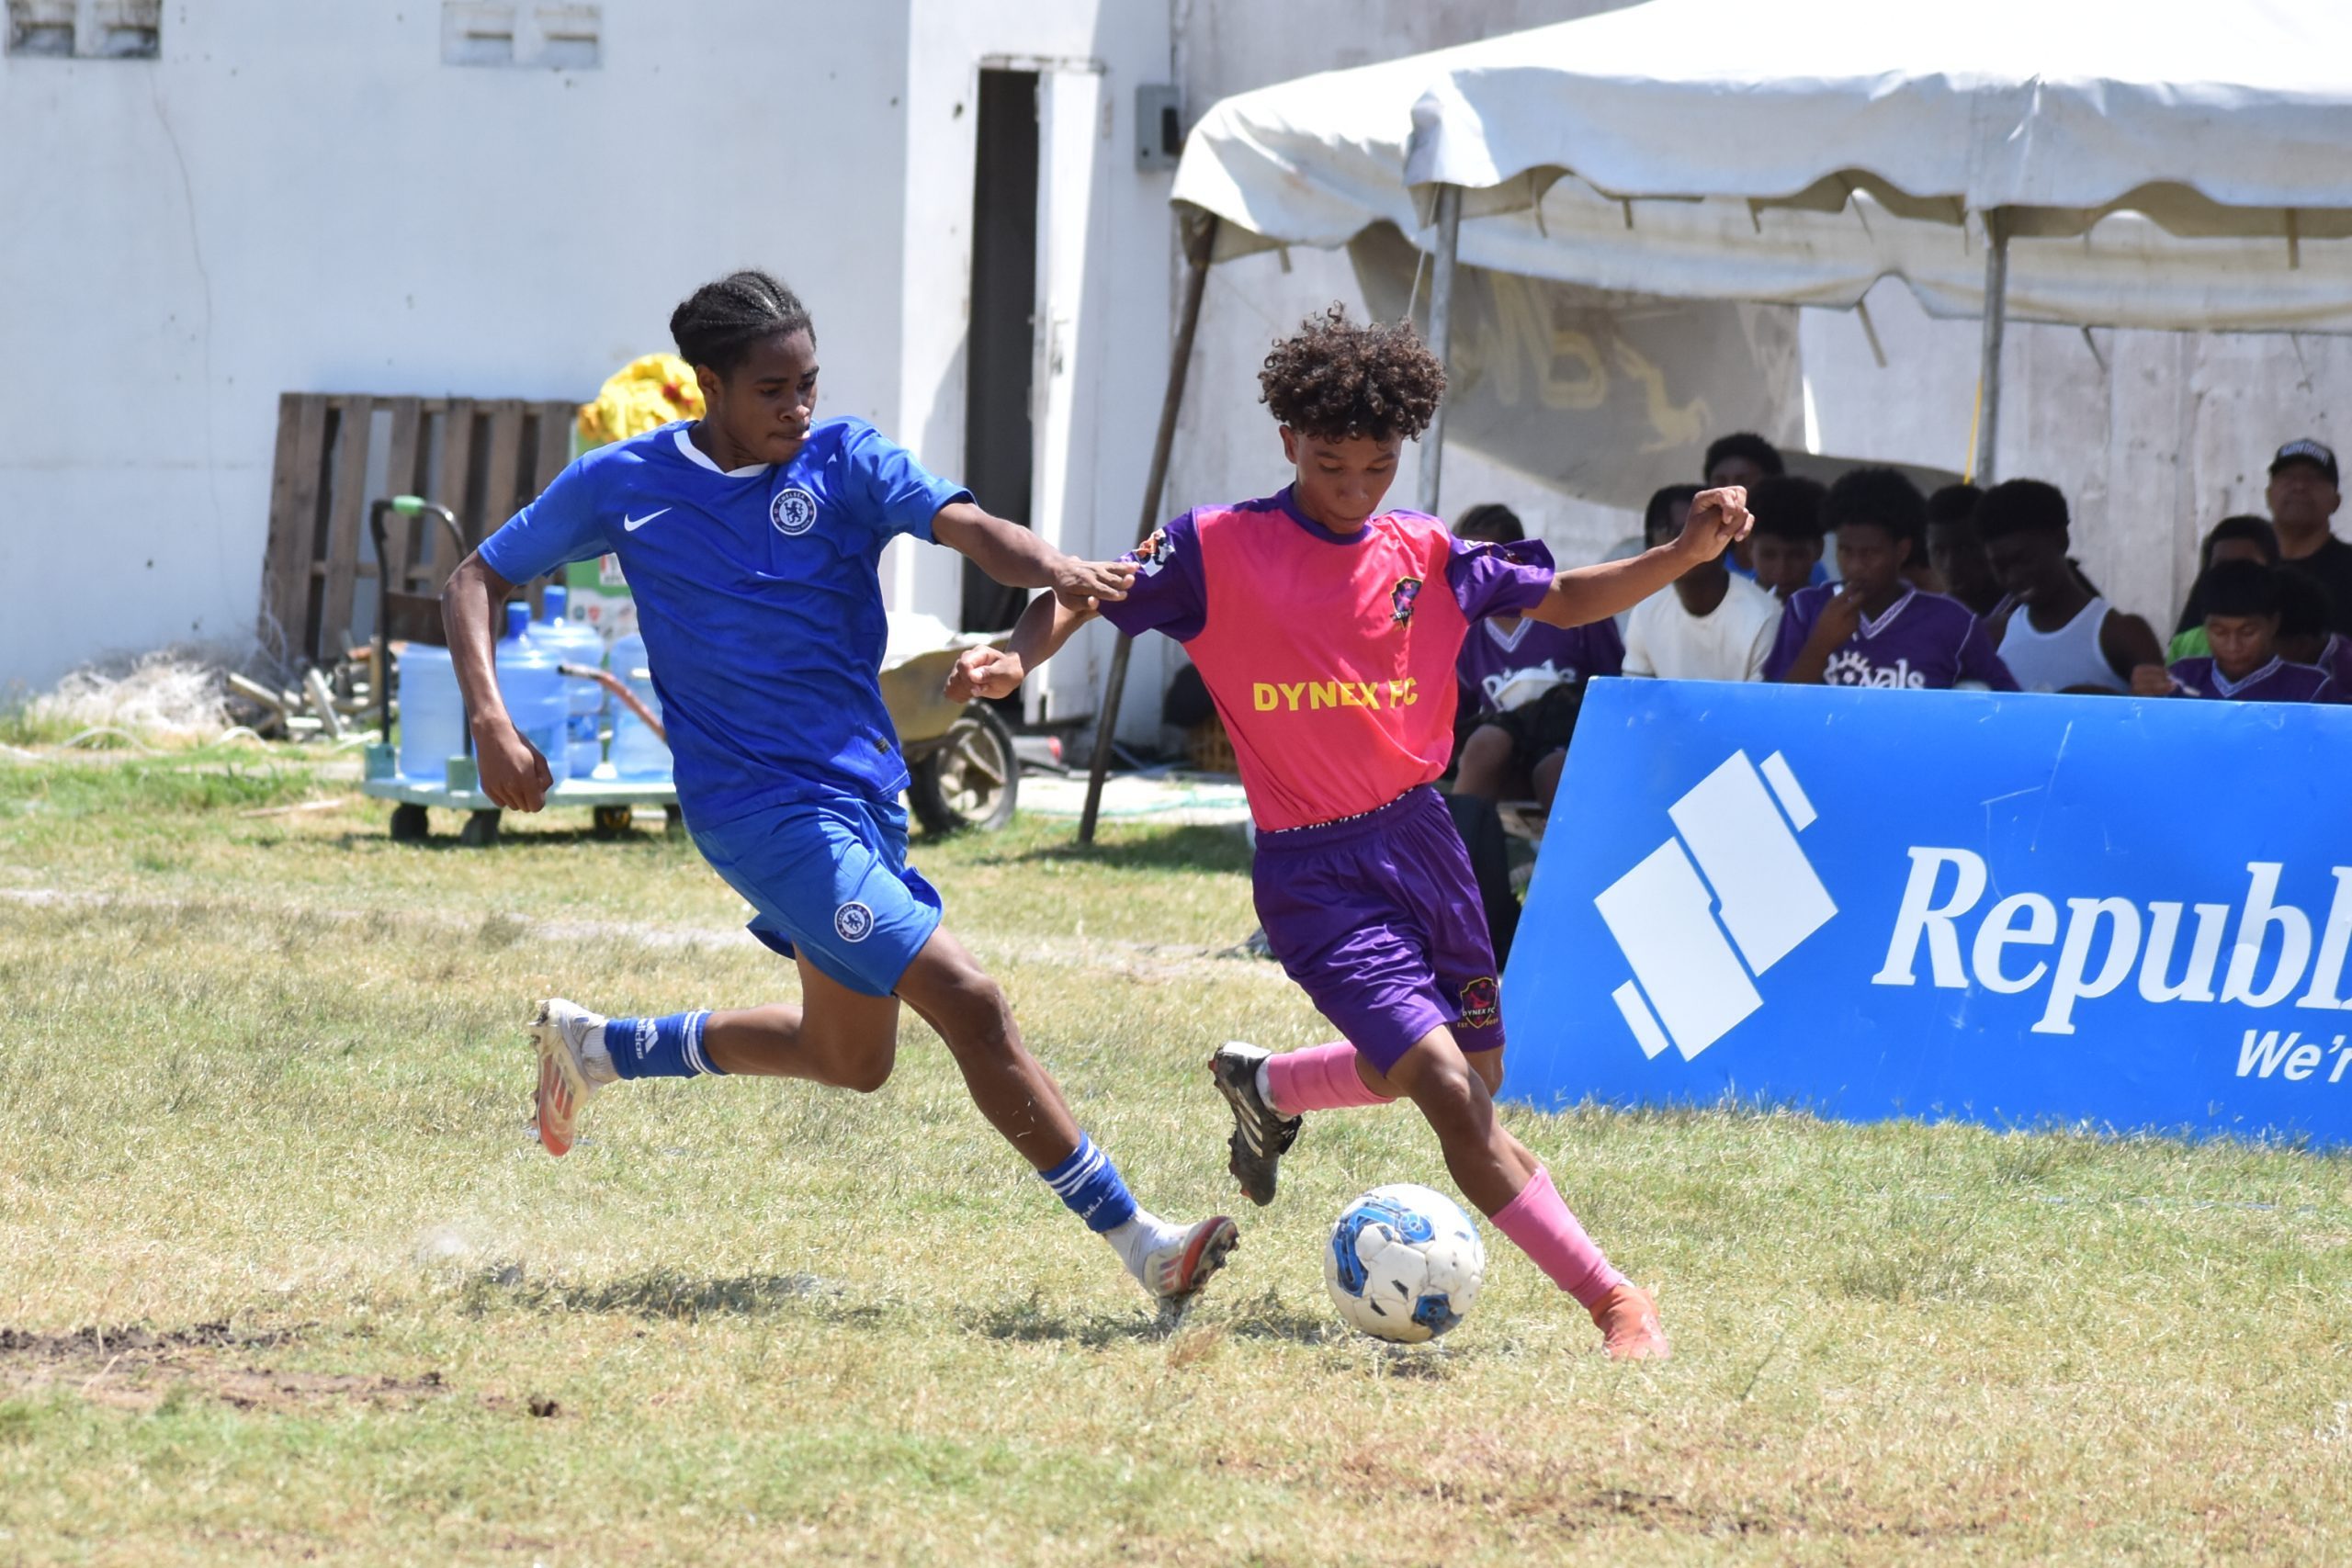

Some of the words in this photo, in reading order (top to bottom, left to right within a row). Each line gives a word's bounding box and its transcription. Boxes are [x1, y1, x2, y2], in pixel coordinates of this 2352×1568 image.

[777, 491, 805, 504] CHELSEA
[1252, 681, 1381, 711] DYNEX
[1388, 677, 1419, 709] FC
[1871, 846, 2352, 1034] Republ
[1463, 1009, 1487, 1017] DYNEX
[635, 1019, 647, 1059] didas
